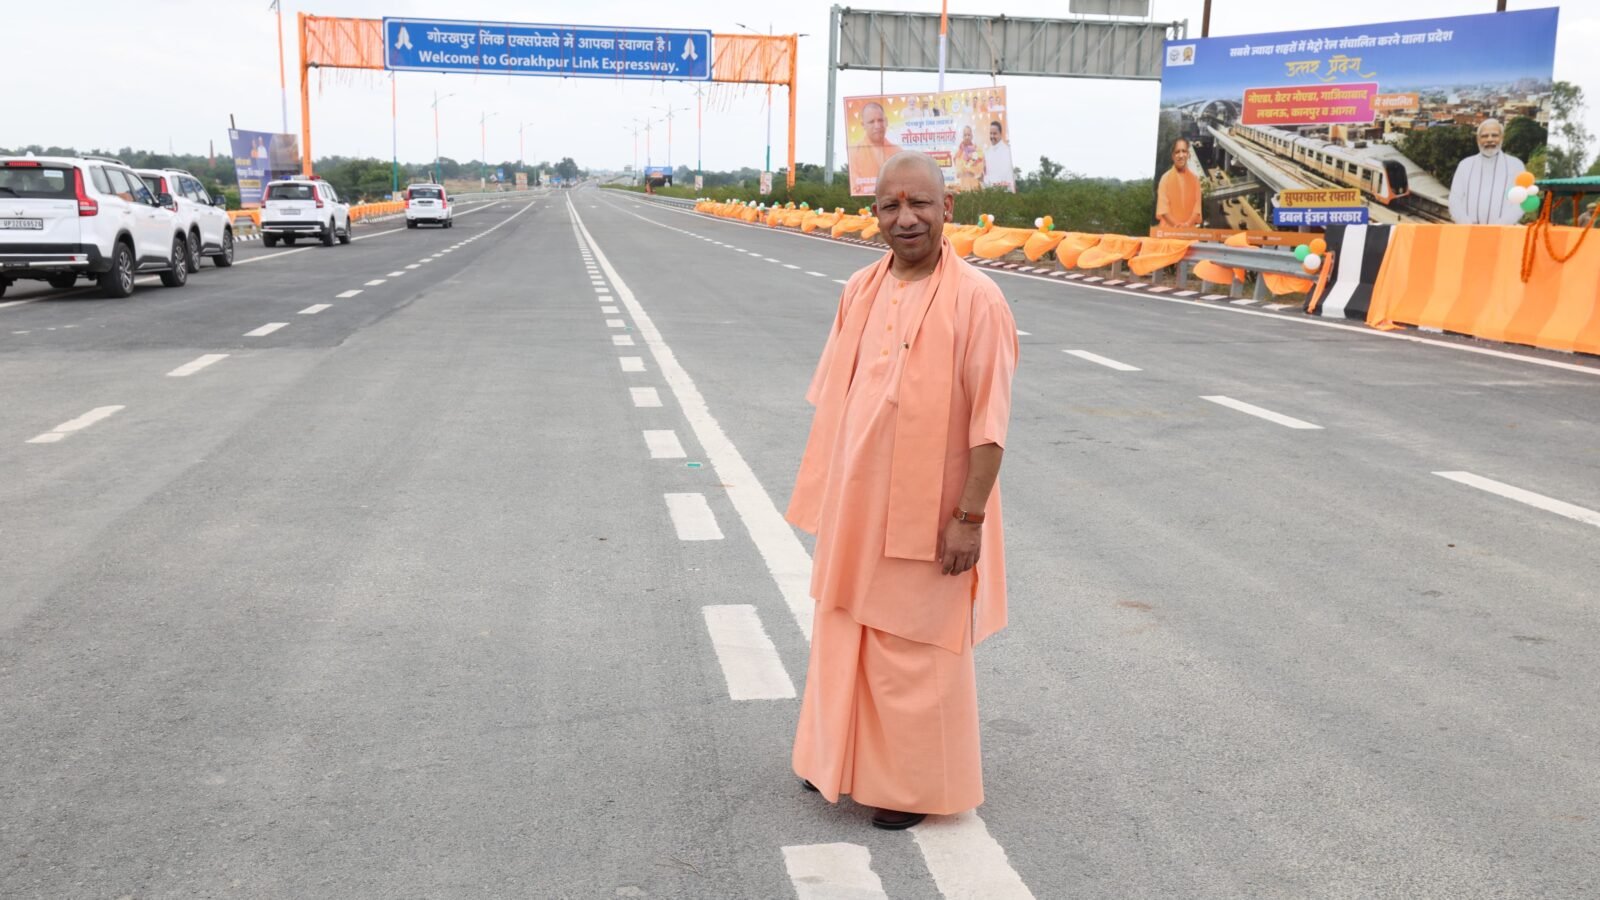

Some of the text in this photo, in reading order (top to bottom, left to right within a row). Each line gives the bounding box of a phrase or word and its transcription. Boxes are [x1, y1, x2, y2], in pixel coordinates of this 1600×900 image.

[427, 28, 475, 48] गोरखपुर
[479, 30, 505, 45] लिंक
[508, 31, 560, 47] एक्सप्रेसवे
[564, 32, 574, 47] में
[578, 37, 614, 50] आपका
[618, 37, 654, 51] स्वागत
[1229, 29, 1454, 57] सबसे ज्यादा शहरों में मेट्रो रेल संचालित करने वाला प्रदेश
[419, 50, 679, 74] Welcome to Gorakhpur Link Expressway.
[1285, 54, 1376, 82] उत्तर प्रदेश
[1248, 91, 1273, 104] नोएडा,
[1292, 90, 1319, 102] नोएडा,
[1291, 107, 1320, 120] कानपुर
[1322, 107, 1329, 116] व
[1330, 106, 1356, 116] आगरा
[1284, 190, 1356, 206] सुपरफास्ट रफ्तार
[1279, 209, 1363, 225] डबल इंजन सरकार
